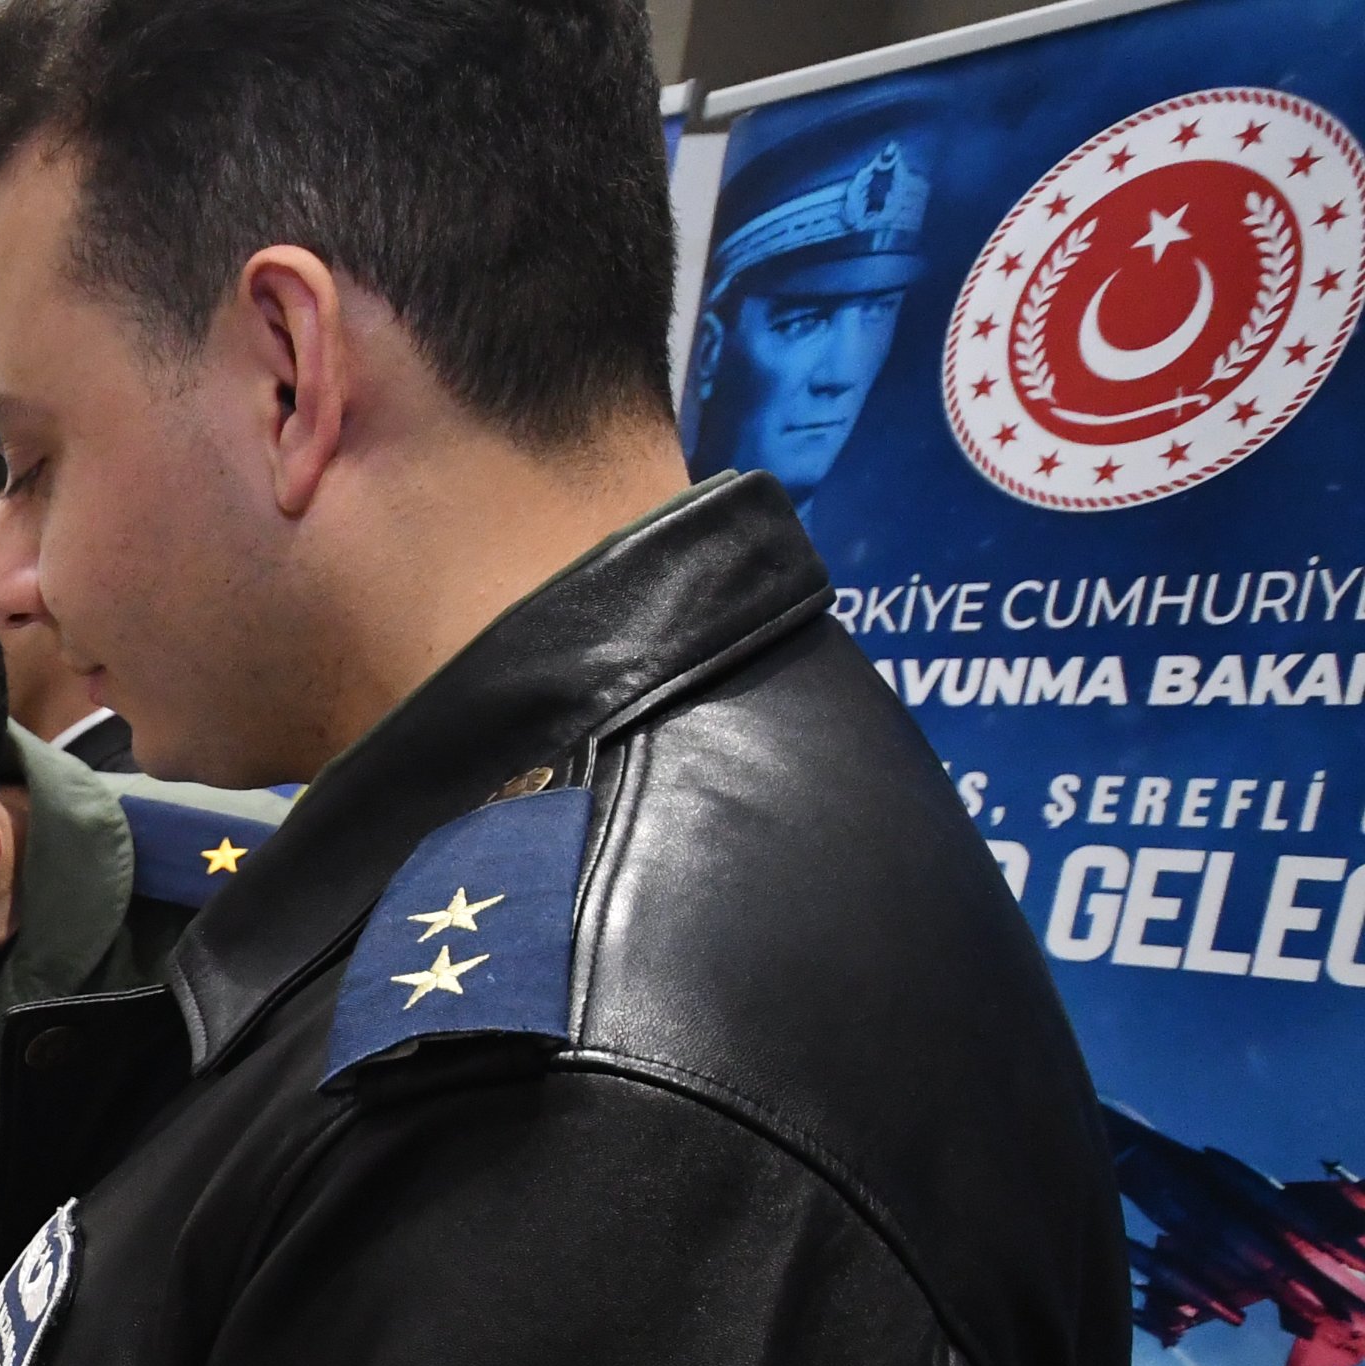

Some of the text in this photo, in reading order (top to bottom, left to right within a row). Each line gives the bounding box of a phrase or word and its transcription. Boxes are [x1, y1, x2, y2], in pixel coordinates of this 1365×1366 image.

[825, 555, 1365, 635] RKİYE CUMHURİY
[1042, 769, 1327, 832] ŞEREFLİ
